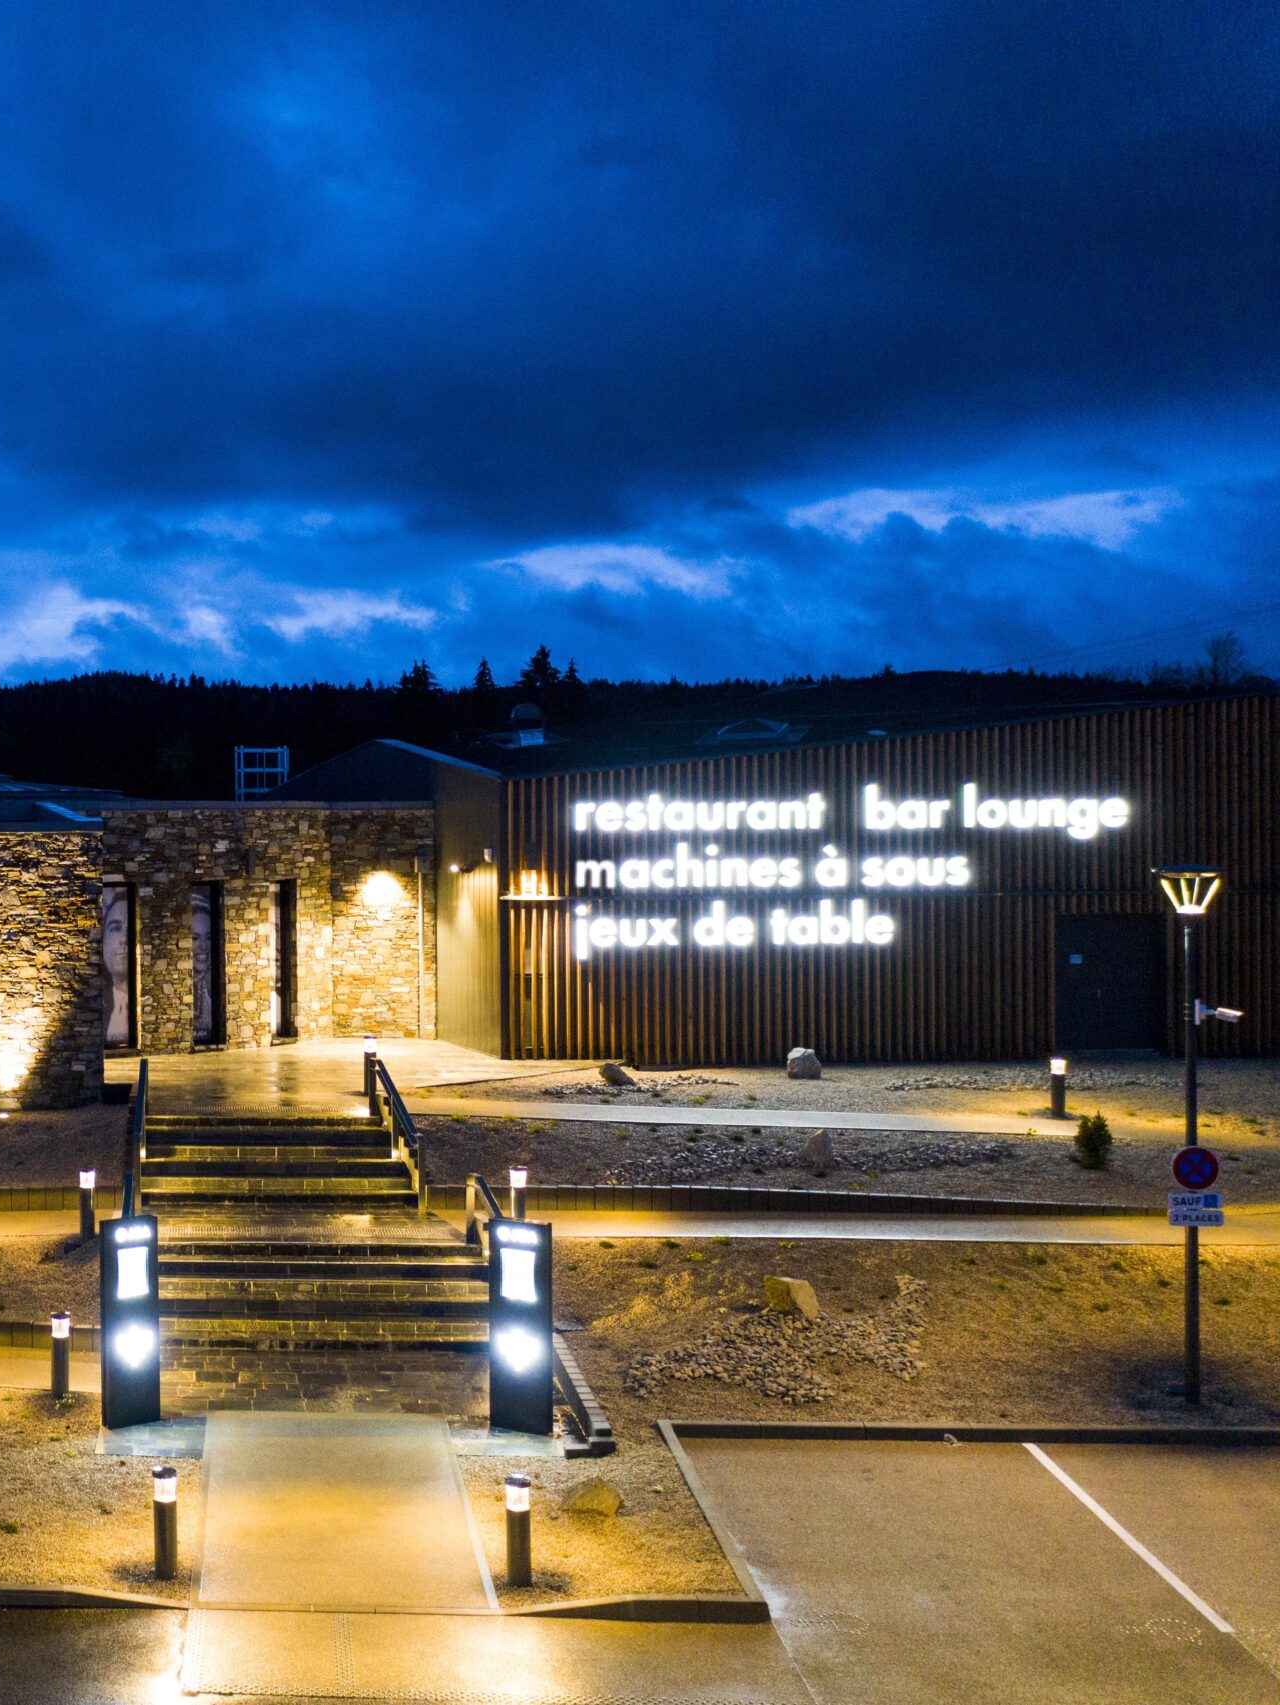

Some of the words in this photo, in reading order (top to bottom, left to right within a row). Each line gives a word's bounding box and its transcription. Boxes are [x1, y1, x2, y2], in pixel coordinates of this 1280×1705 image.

[574, 793, 827, 833] restaurant
[864, 783, 950, 831] bar
[963, 782, 1130, 840] lounge
[576, 842, 802, 889] machines
[815, 845, 849, 887] à
[861, 855, 971, 887] sous
[576, 904, 680, 960] jeux
[691, 899, 757, 947] de
[768, 898, 896, 946] table
[1173, 1197, 1201, 1206] SAUF
[1182, 1214, 1220, 1222] PLACES
